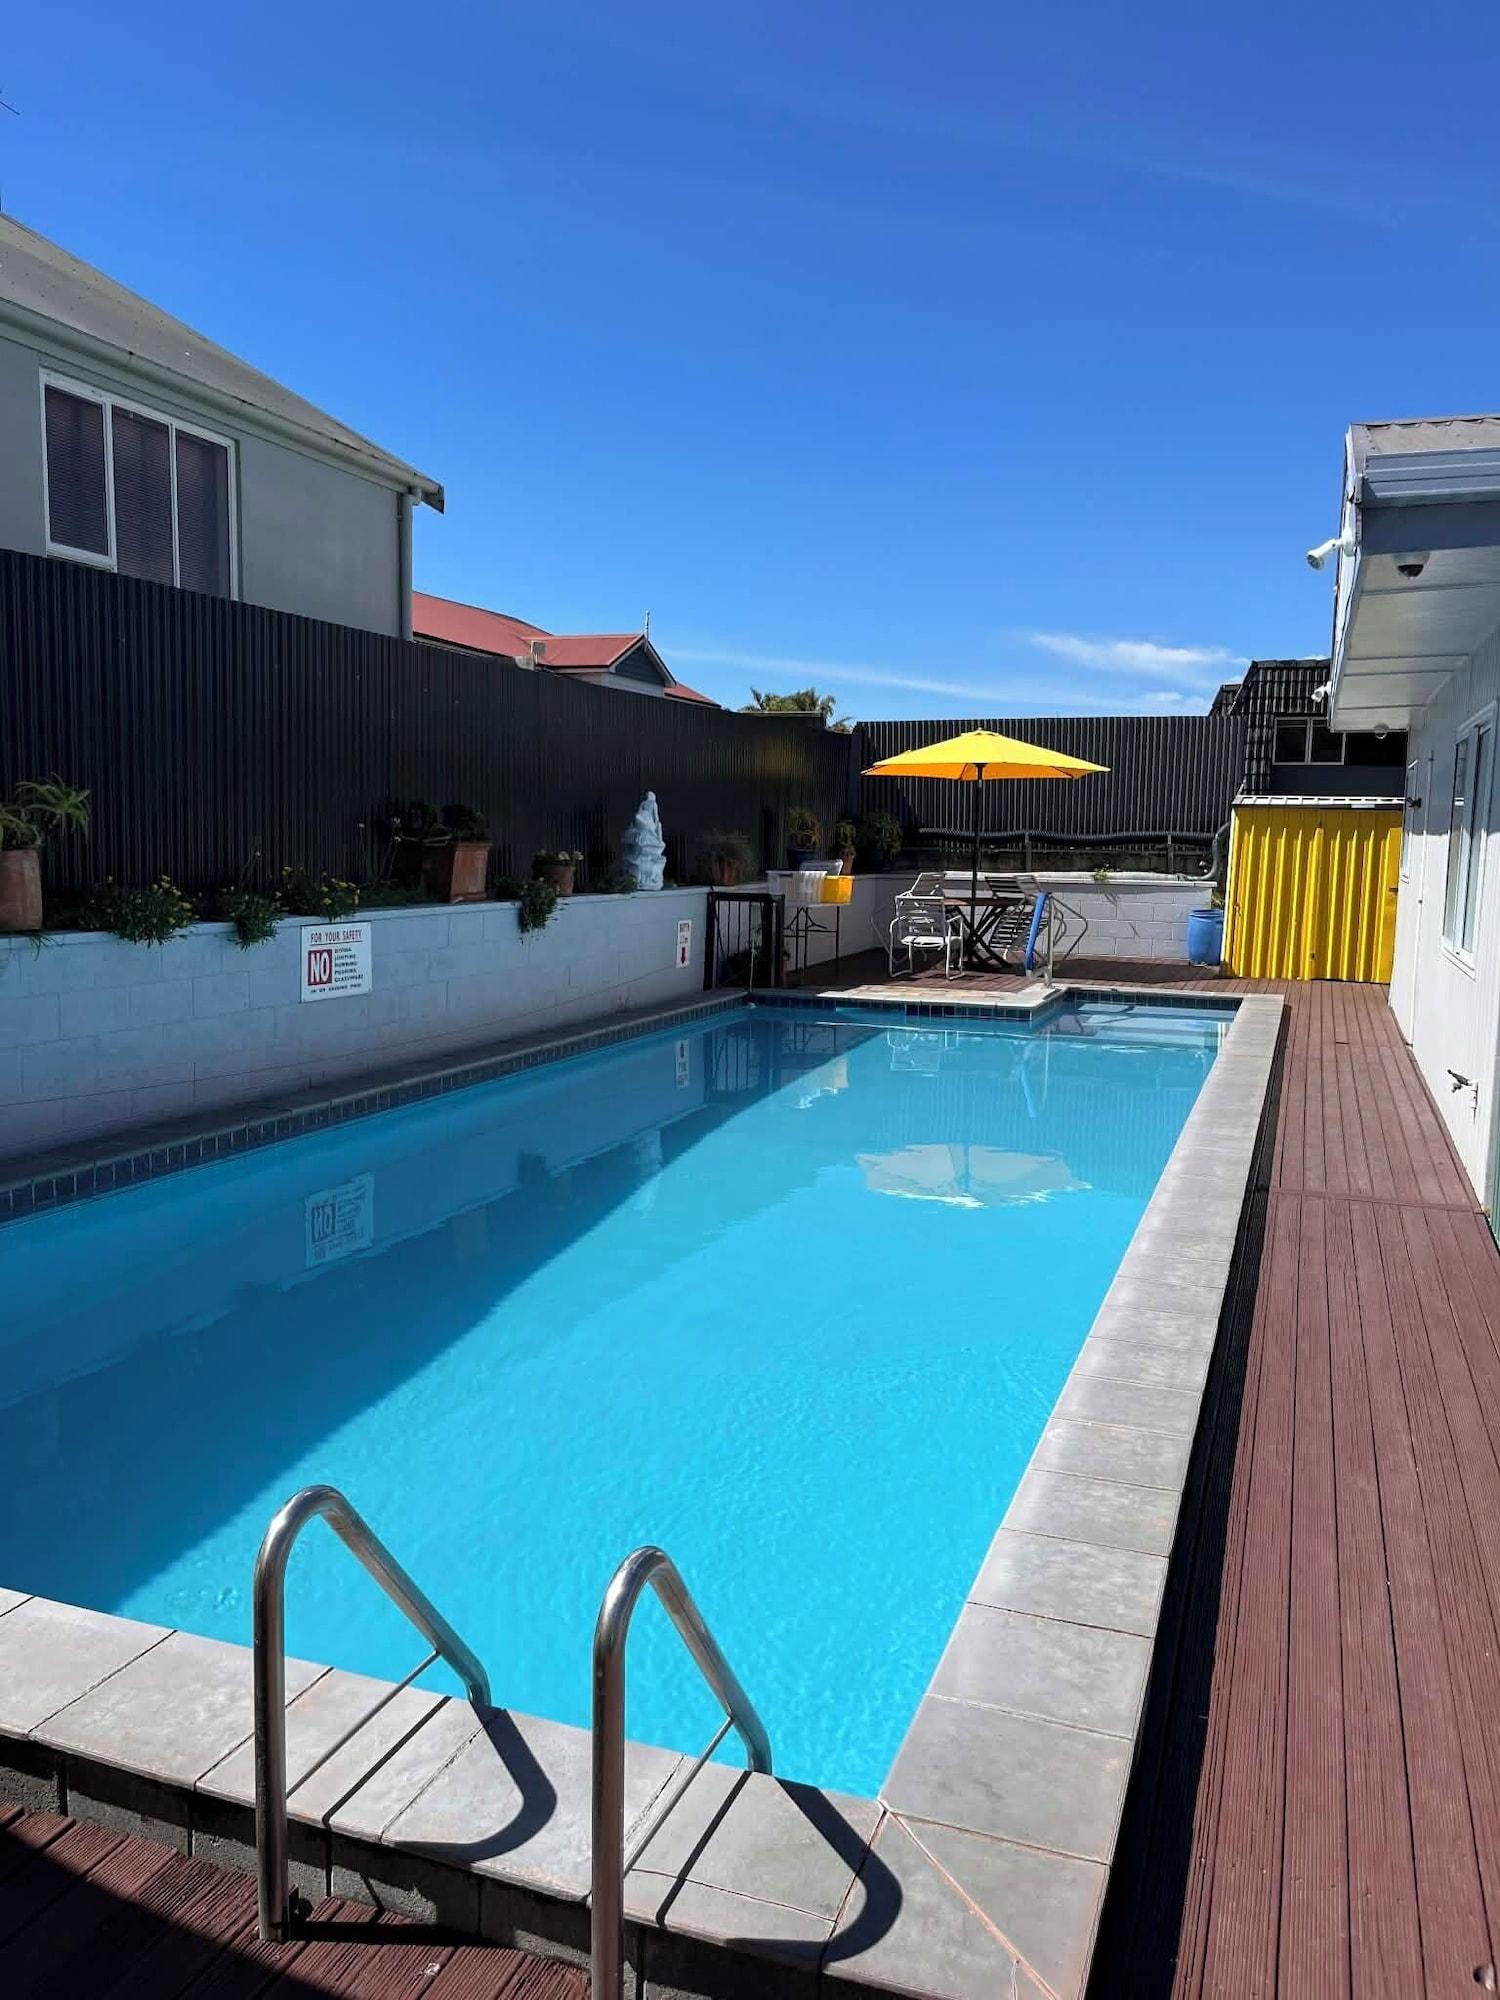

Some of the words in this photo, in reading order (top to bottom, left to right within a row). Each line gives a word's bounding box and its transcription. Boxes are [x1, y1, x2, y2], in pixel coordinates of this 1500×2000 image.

[311, 933, 322, 944] FOR
[325, 931, 340, 942] YOUR
[343, 929, 362, 940] SAFETY
[310, 952, 330, 983] NO
